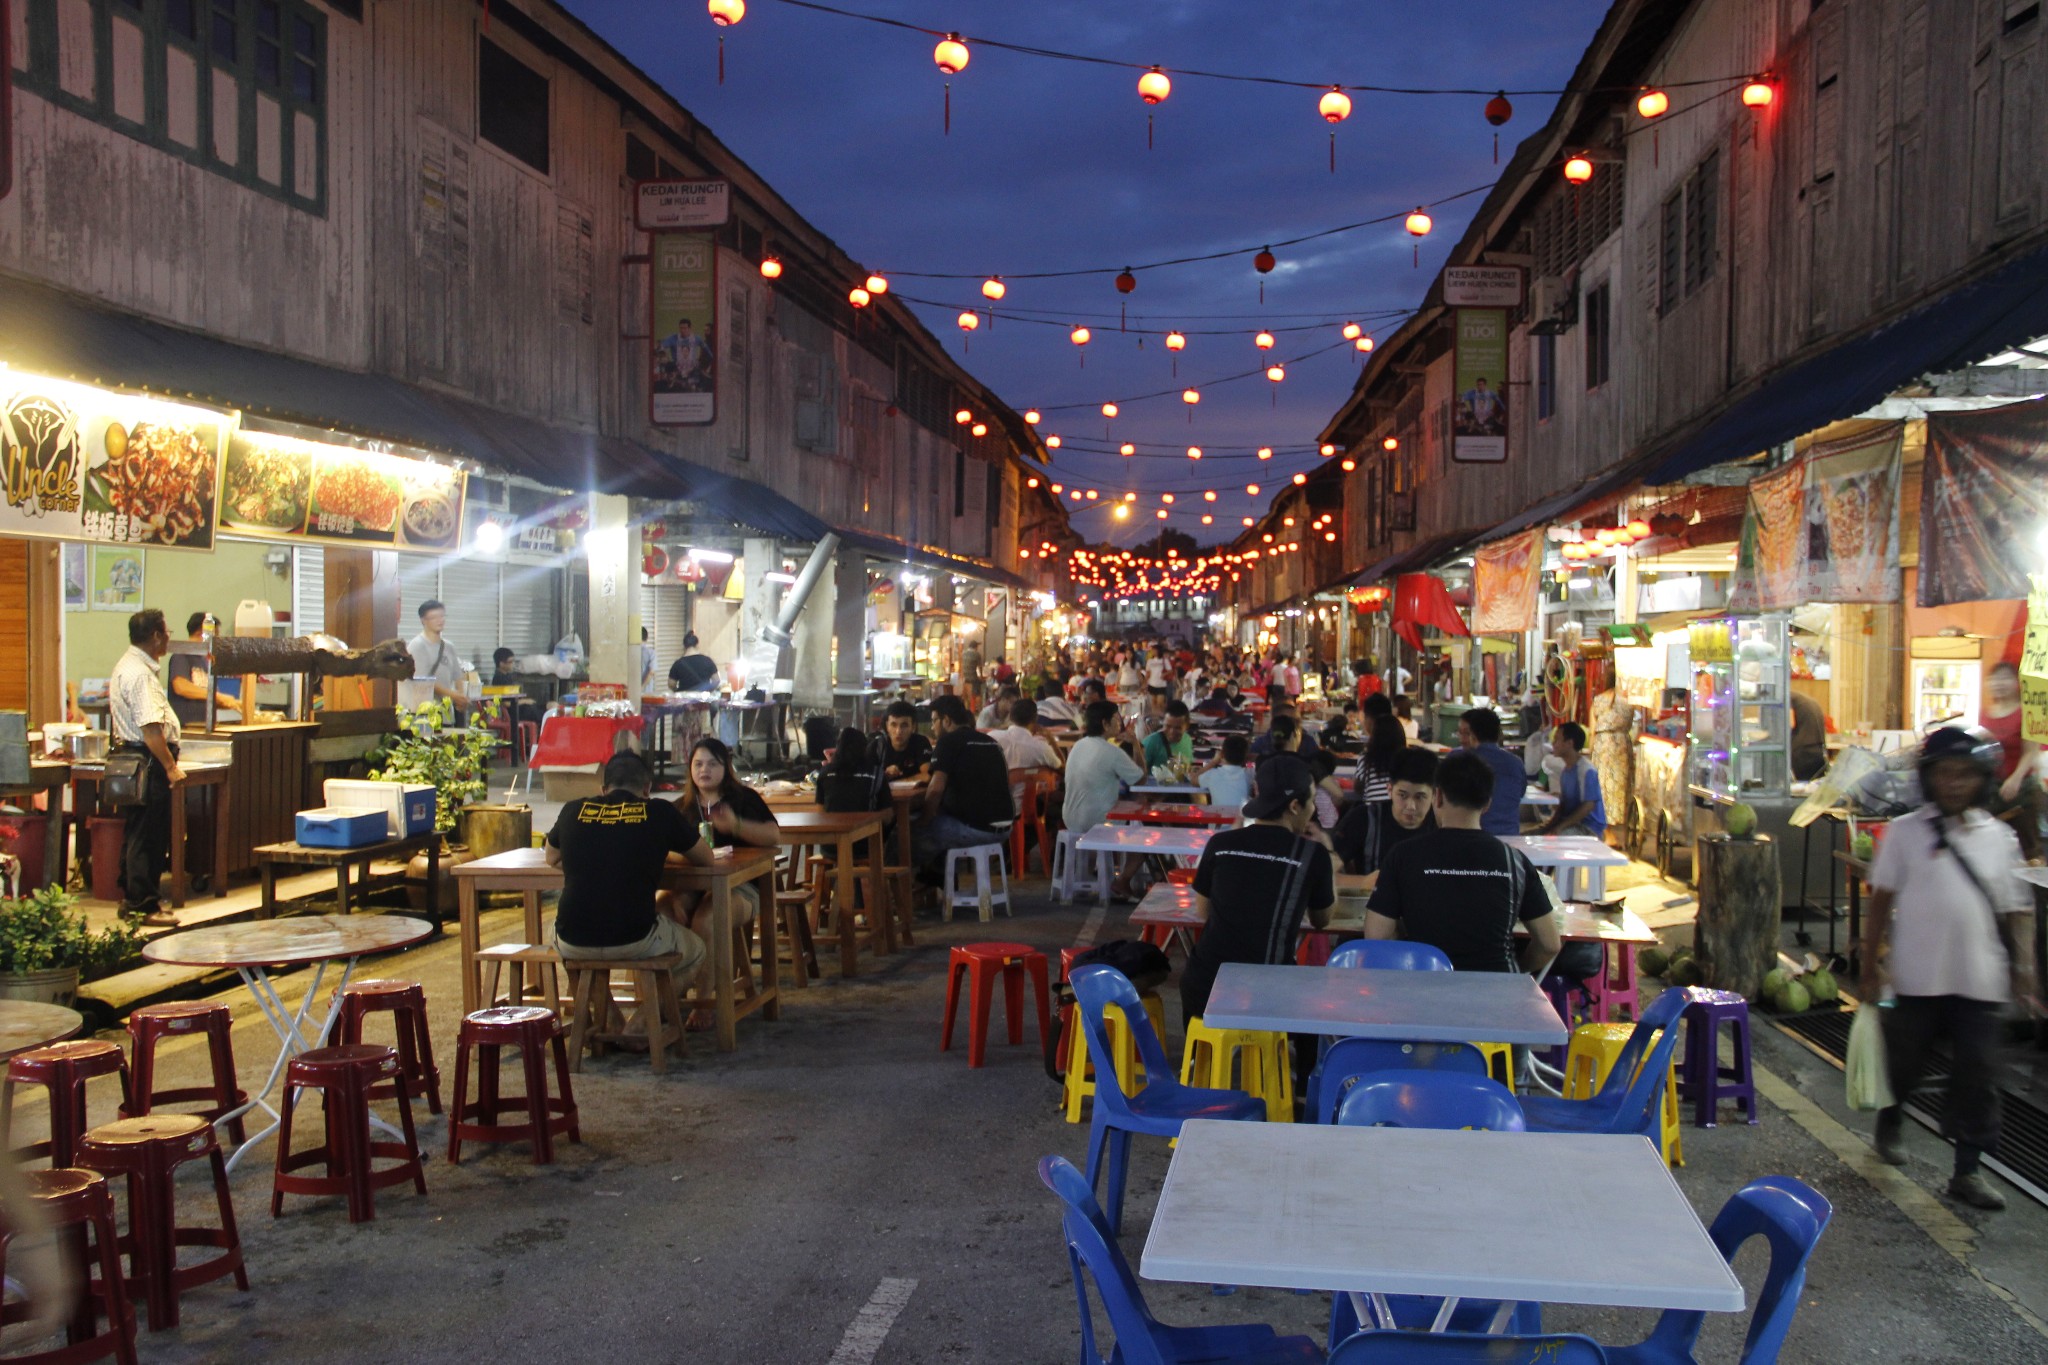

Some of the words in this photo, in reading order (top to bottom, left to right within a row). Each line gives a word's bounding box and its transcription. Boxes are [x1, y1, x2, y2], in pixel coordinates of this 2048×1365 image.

[641, 185, 678, 196] KEDAI
[681, 183, 724, 195] RUNCIT
[660, 197, 672, 206] LIM
[692, 196, 706, 205] LEE
[1448, 270, 1479, 279] KEDAI
[1481, 271, 1517, 280] RUNCIT
[6, 444, 81, 507] Uncle
[40, 496, 81, 513] corner
